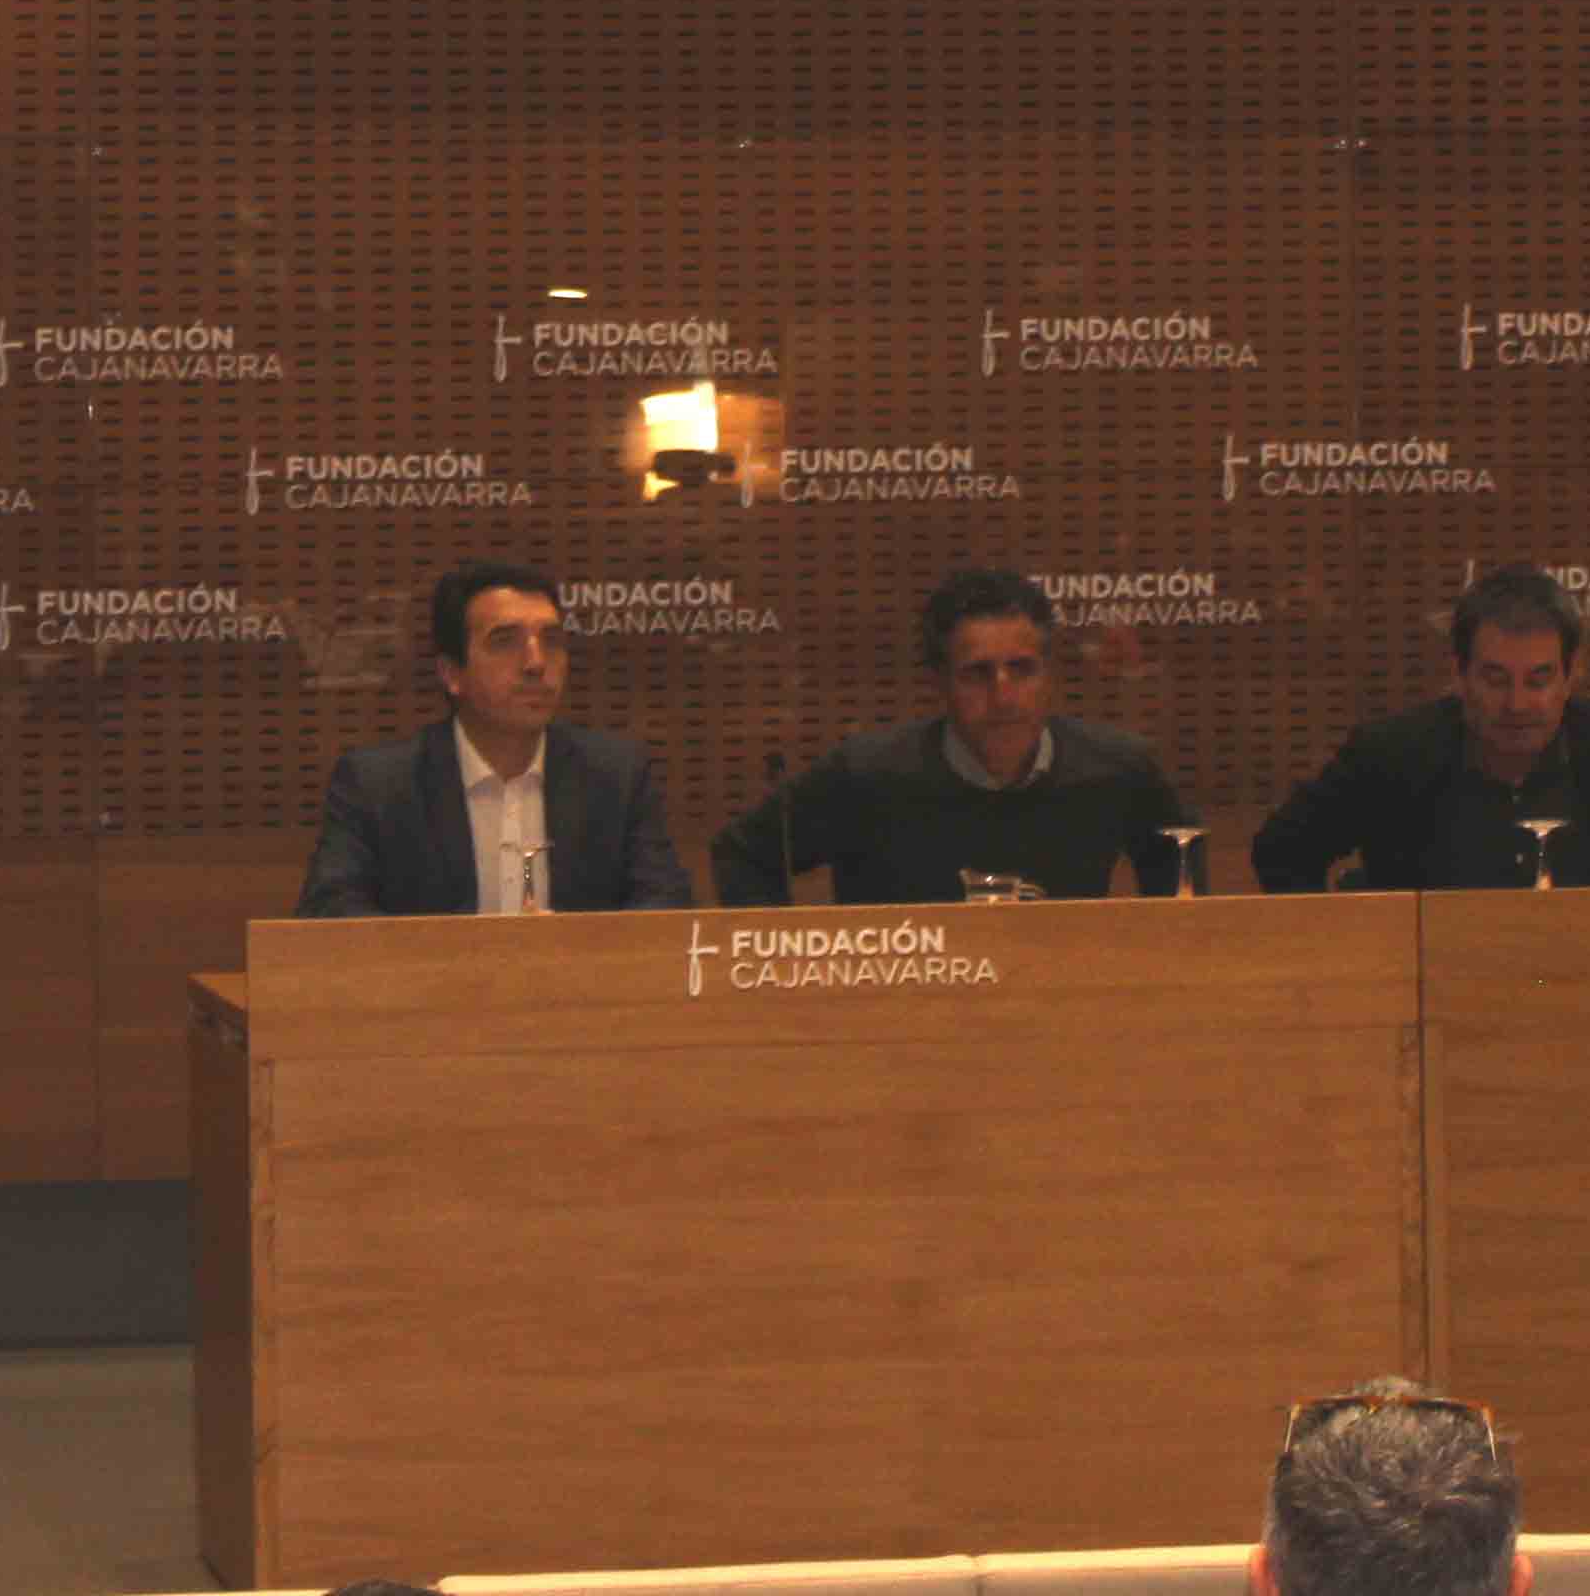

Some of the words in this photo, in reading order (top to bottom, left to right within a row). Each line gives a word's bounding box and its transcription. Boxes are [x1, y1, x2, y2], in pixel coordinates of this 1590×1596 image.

[35, 323, 234, 352] FUNDACIÓN
[534, 319, 728, 347] FUNDACIÓN
[1021, 312, 1211, 342] FUNDACIÓN
[34, 354, 283, 382] CAJANAVARRA
[533, 349, 778, 377] CAJANAVARRA
[1020, 343, 1258, 370] CAJANAVARRA
[286, 450, 482, 479] FUNDACIÓN
[781, 446, 973, 473] FUNDACIÓN
[1261, 439, 1448, 468] FUNDACIÓN
[286, 480, 532, 508] CAJANAVARRA
[780, 474, 1020, 502] CAJANAVARRA
[1260, 469, 1496, 495] CAJANAVARRA
[37, 586, 236, 616] FUNDACIÓN
[557, 573, 732, 607] UNDACIÓN
[562, 607, 781, 636] AJANAVARRA
[1050, 600, 1261, 628] AJANAVARRA
[36, 617, 285, 646] CAJANAVARRA
[732, 921, 945, 958] FUNDACIÓN
[731, 958, 998, 989] CAJANAVARRA
